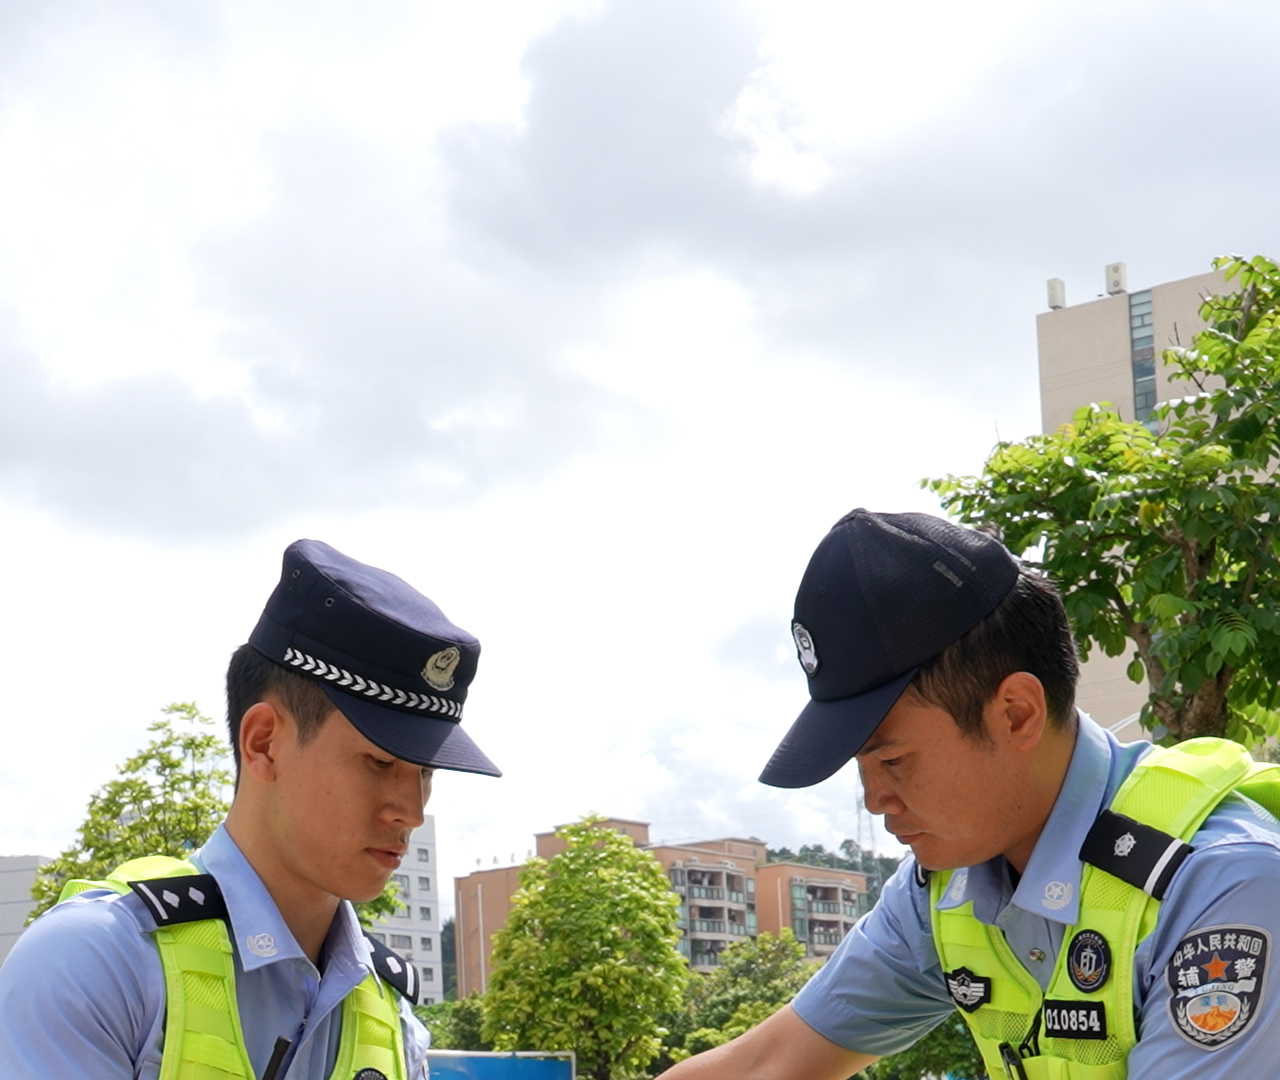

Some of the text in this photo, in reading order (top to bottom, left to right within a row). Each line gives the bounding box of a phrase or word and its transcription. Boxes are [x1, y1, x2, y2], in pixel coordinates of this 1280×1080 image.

[1173, 932, 1263, 967] 中华人民共和国
[1178, 957, 1257, 987] 辅 警
[1046, 1007, 1101, 1032] 010854
